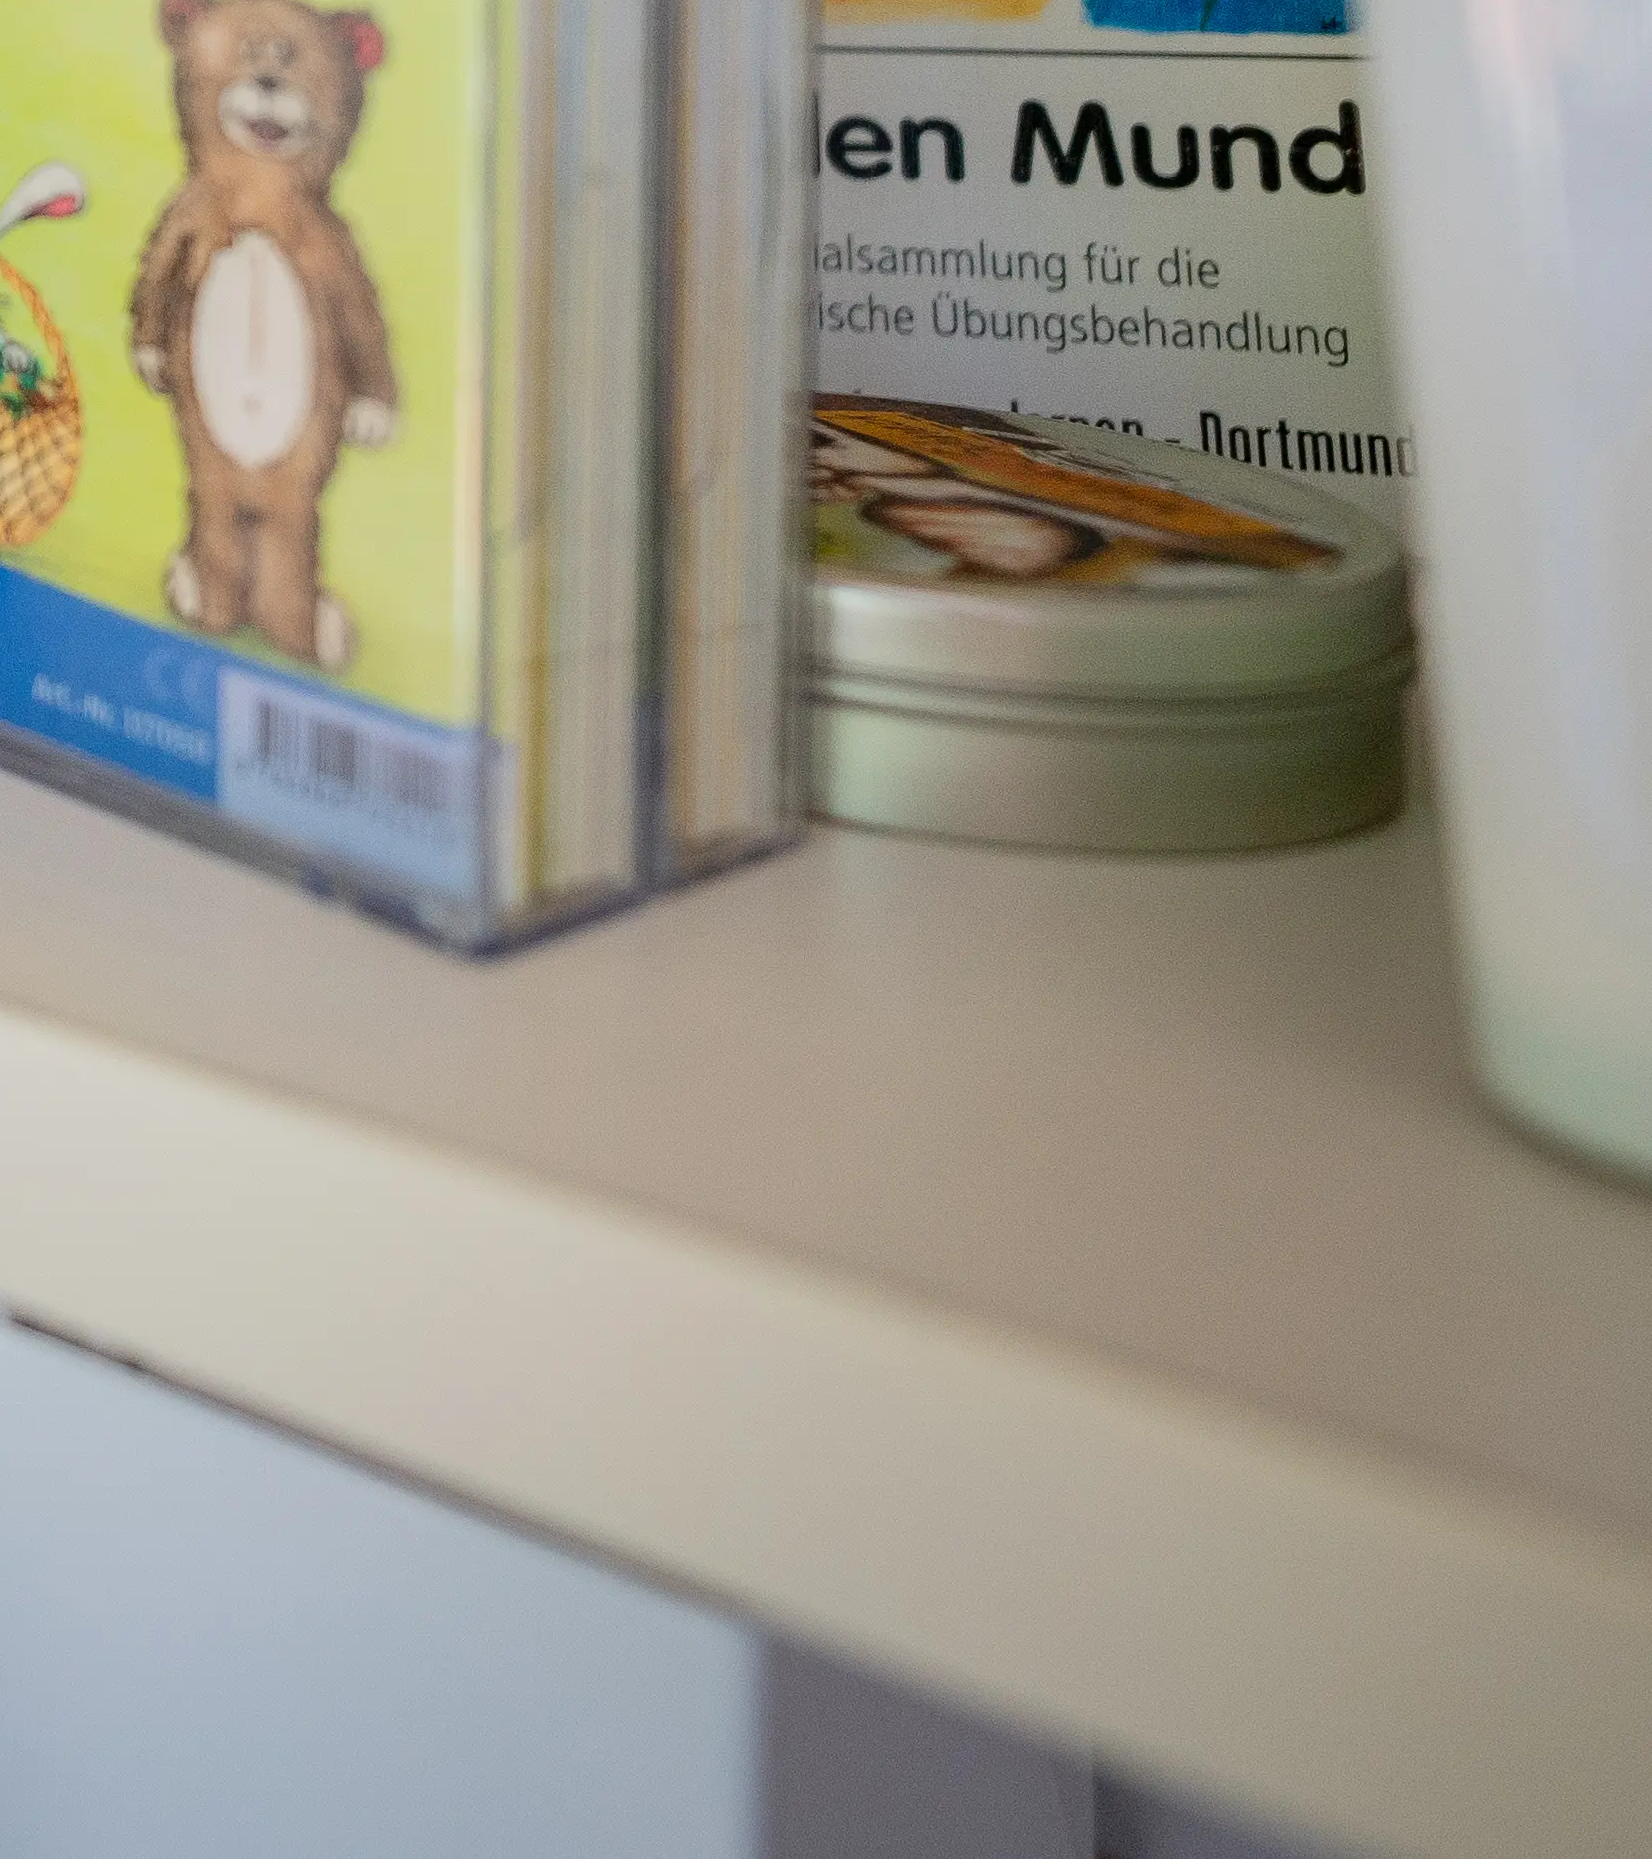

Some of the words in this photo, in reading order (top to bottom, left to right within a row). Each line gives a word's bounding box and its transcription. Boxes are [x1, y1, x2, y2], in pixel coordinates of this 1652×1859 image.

[813, 92, 966, 181] en
[1010, 98, 1368, 196] Mund
[1083, 241, 1141, 285] für
[1157, 245, 1220, 290] die
[931, 290, 1351, 368] Übungsbehandlung
